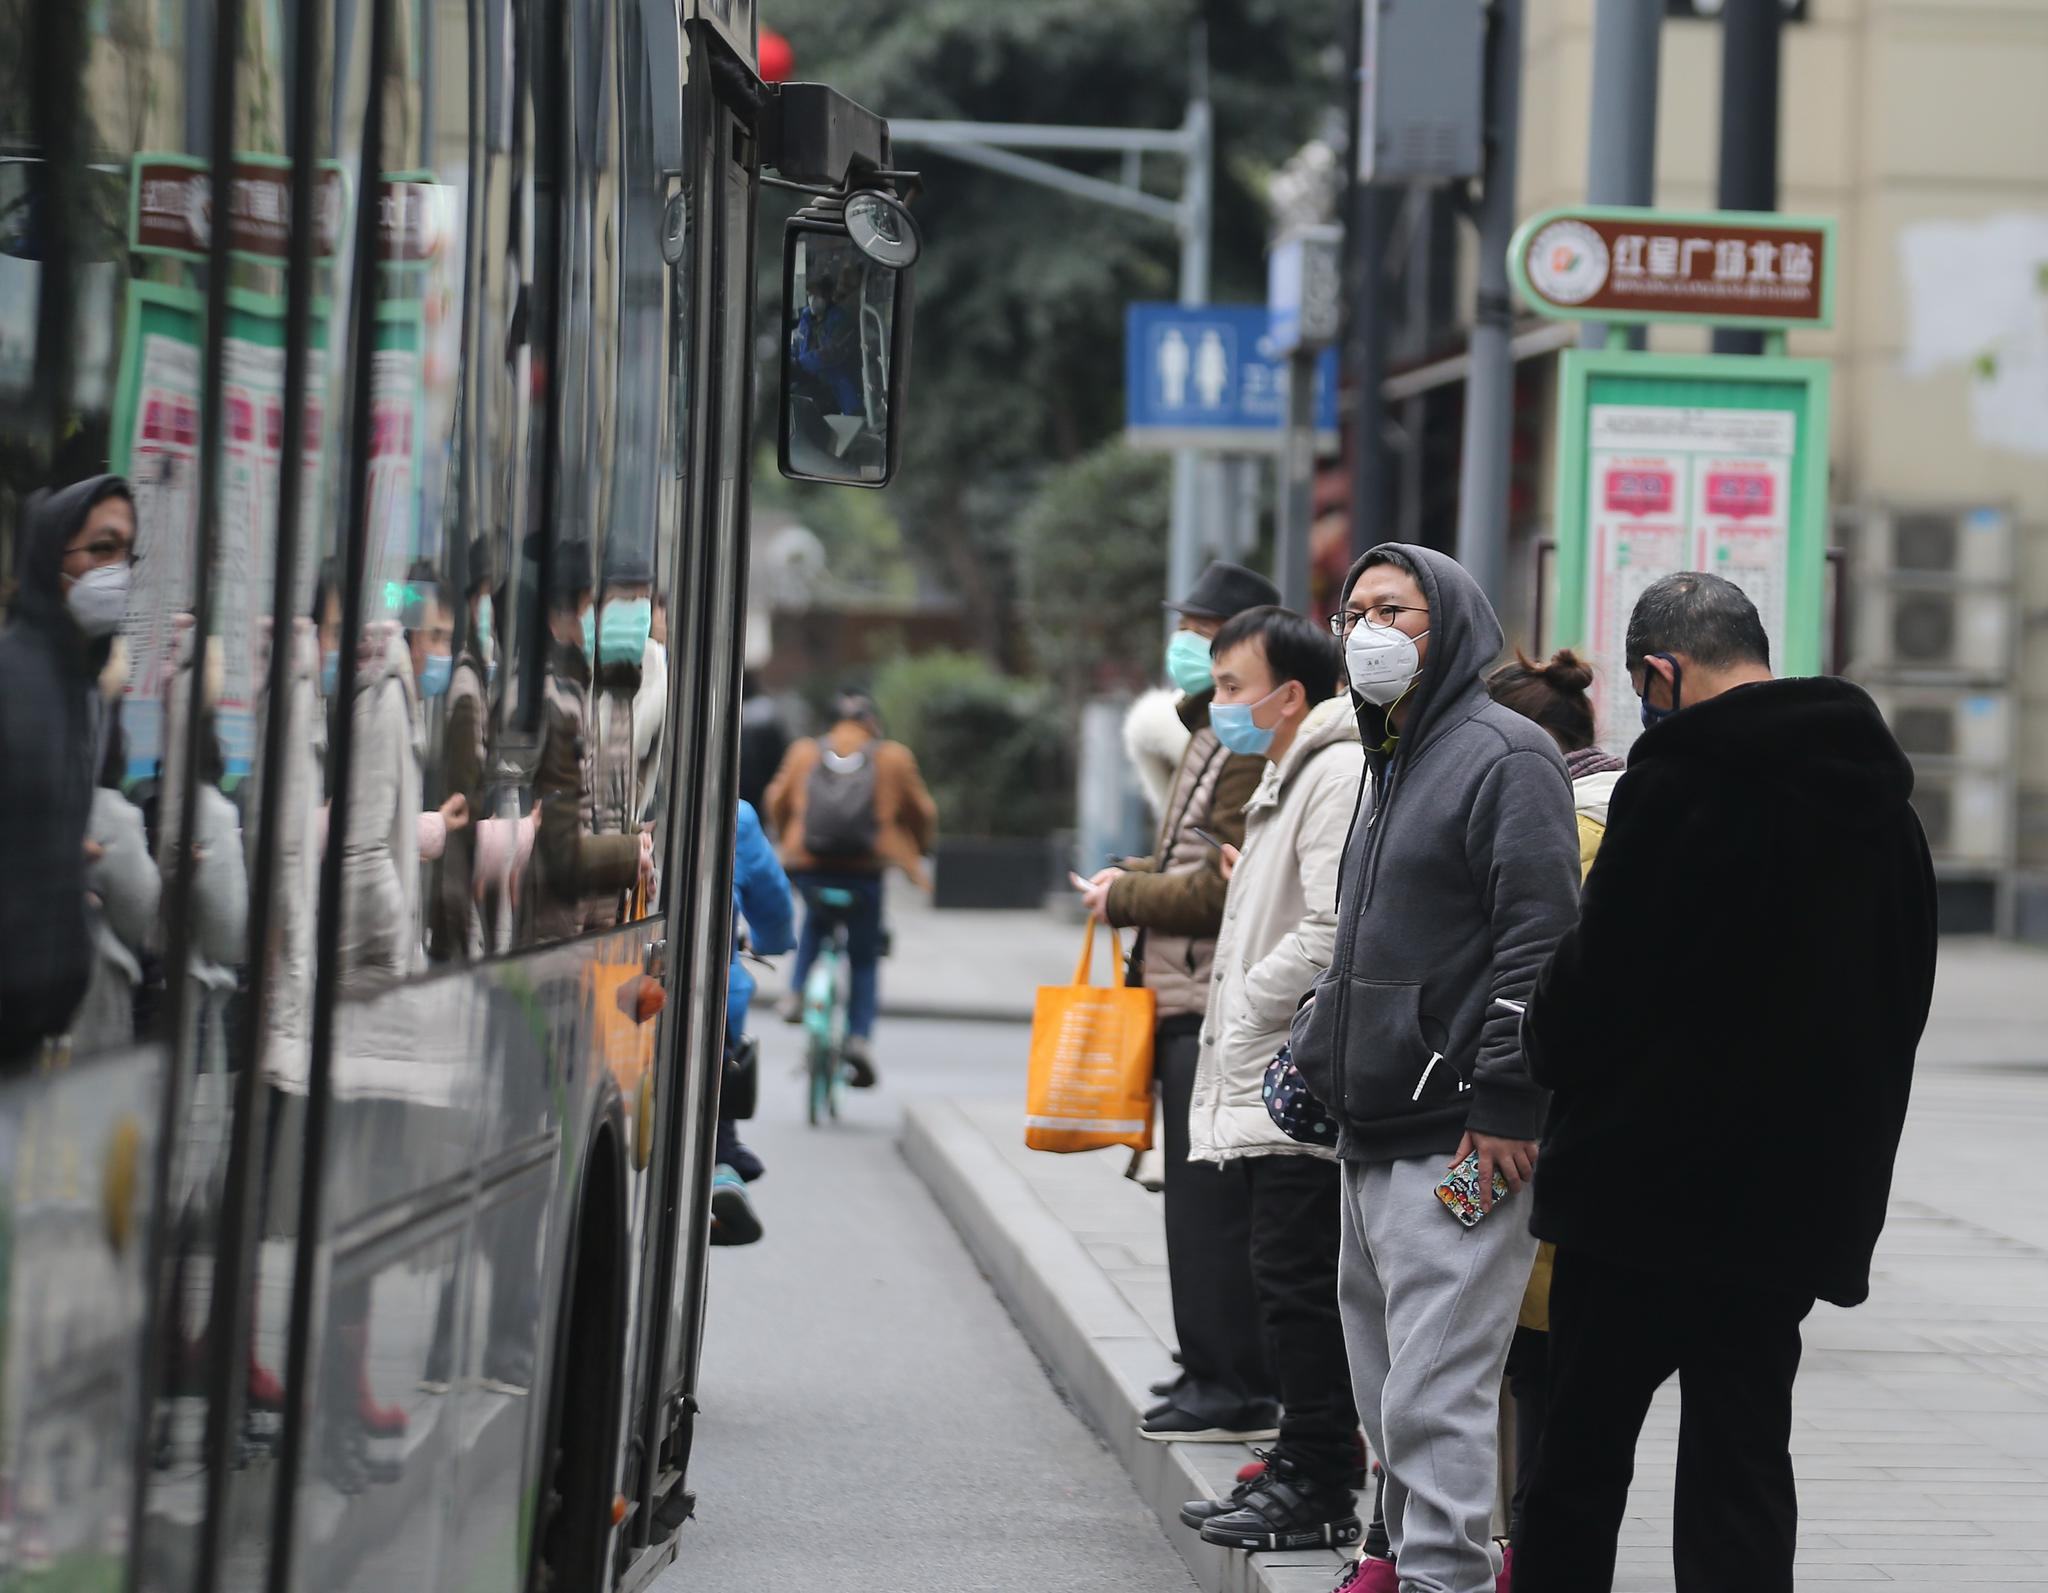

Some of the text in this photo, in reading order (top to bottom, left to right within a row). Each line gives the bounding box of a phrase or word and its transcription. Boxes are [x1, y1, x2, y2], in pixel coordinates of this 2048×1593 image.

[1612, 234, 1814, 283] 红星广场北站
